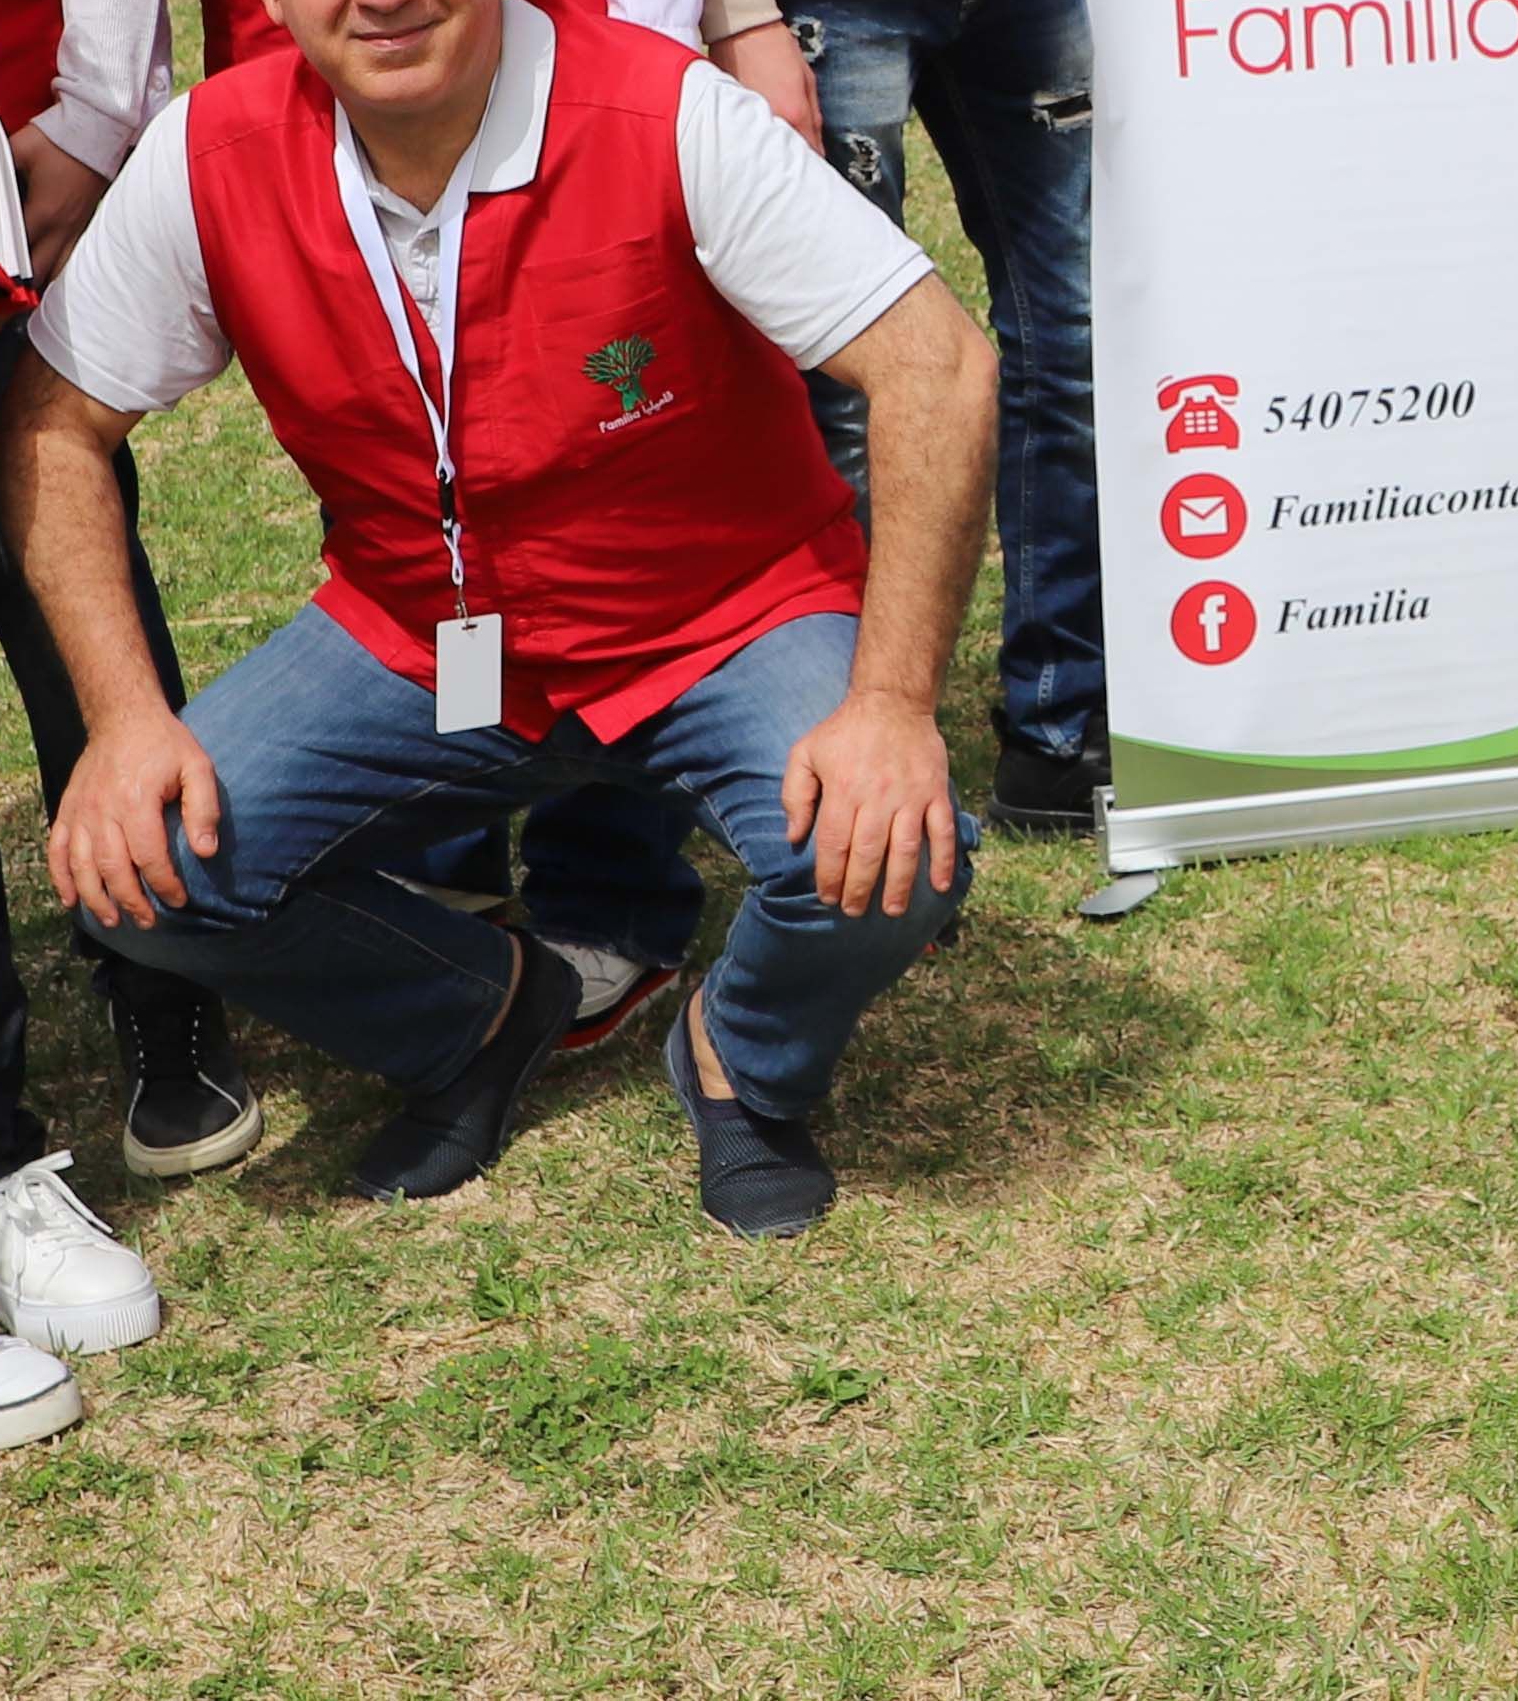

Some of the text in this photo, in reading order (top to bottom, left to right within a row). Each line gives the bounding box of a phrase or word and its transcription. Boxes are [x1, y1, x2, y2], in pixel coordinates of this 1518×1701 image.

[598, 410, 642, 433] Familia
[1263, 380, 1476, 434] 54075200
[1276, 588, 1430, 634] Familia
